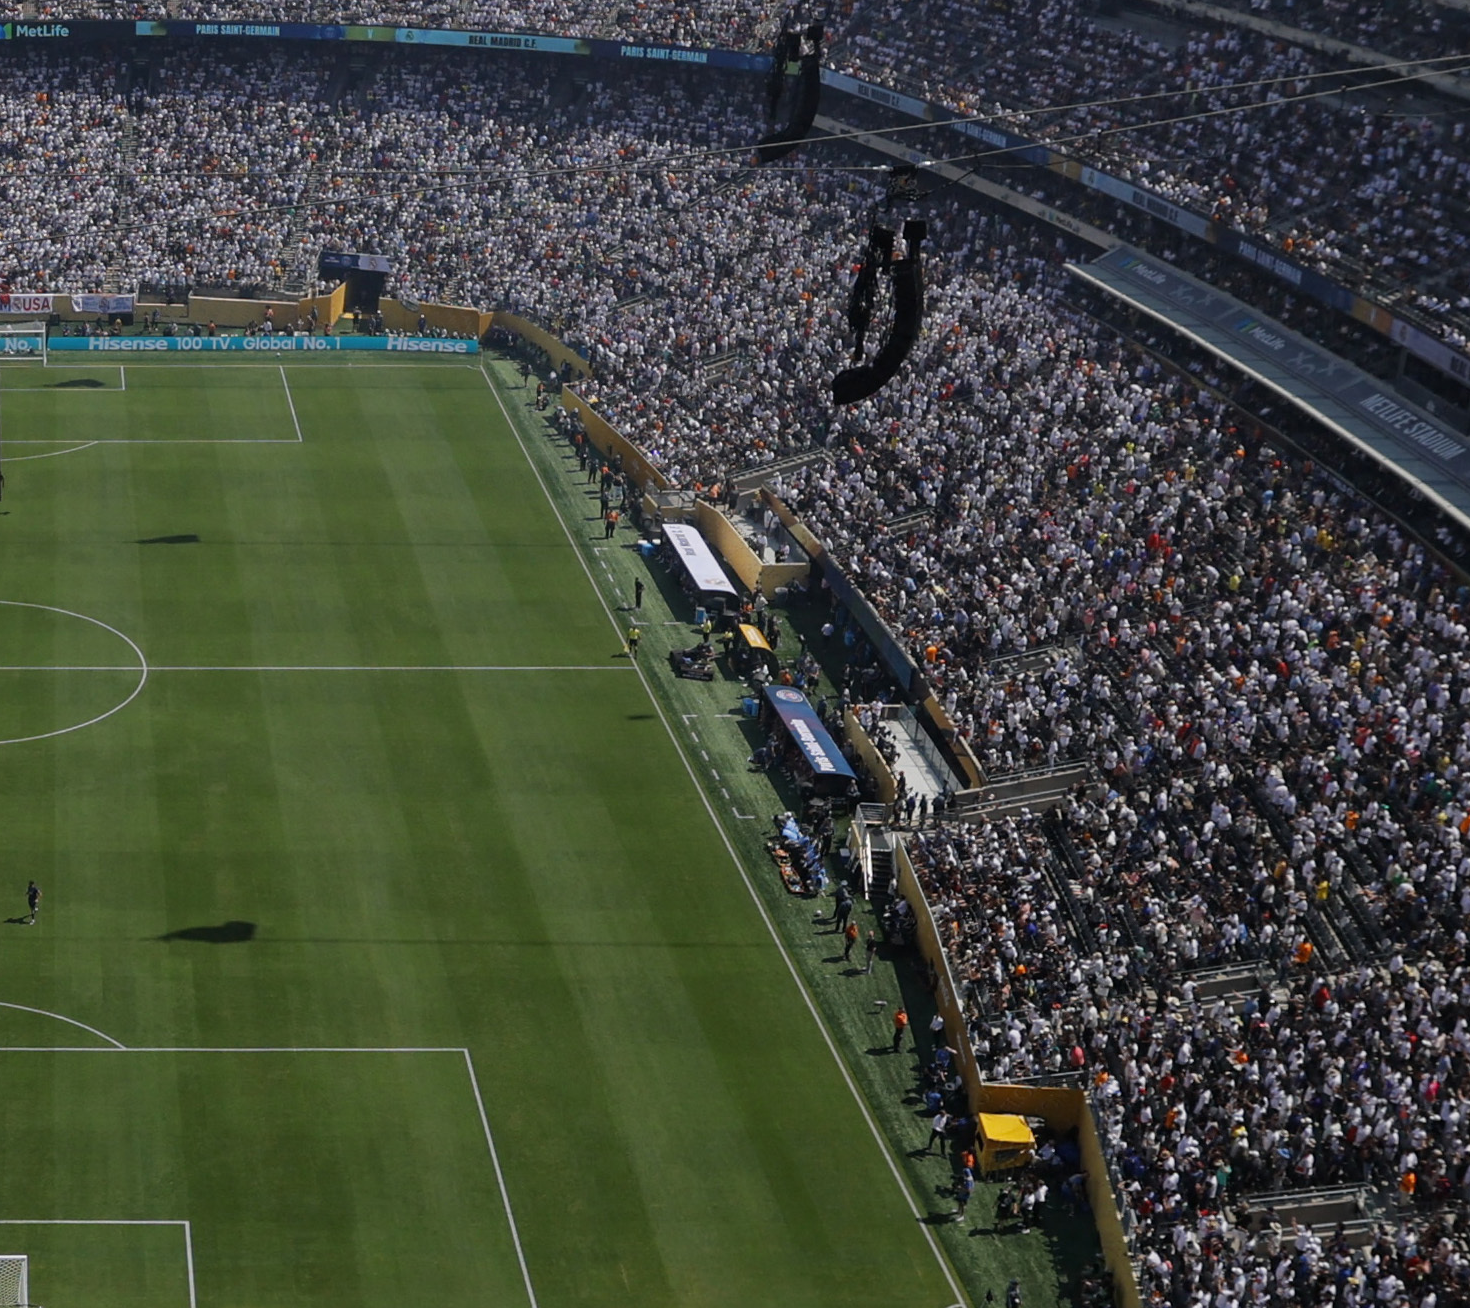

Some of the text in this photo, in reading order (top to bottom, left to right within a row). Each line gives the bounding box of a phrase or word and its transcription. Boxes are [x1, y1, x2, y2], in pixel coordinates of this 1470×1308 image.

[16, 24, 69, 37] MetLife
[196, 24, 219, 35] PARIS
[468, 34, 488, 46] REAL
[621, 45, 708, 64] PARIS SAINT-GERMAIN
[23, 297, 51, 311] USA
[89, 336, 168, 350] Hisense
[243, 337, 296, 350] Global
[387, 338, 467, 353] Hisense
[1247, 326, 1287, 351] MetLife
[1358, 392, 1466, 461] METLIFE STADIUM
